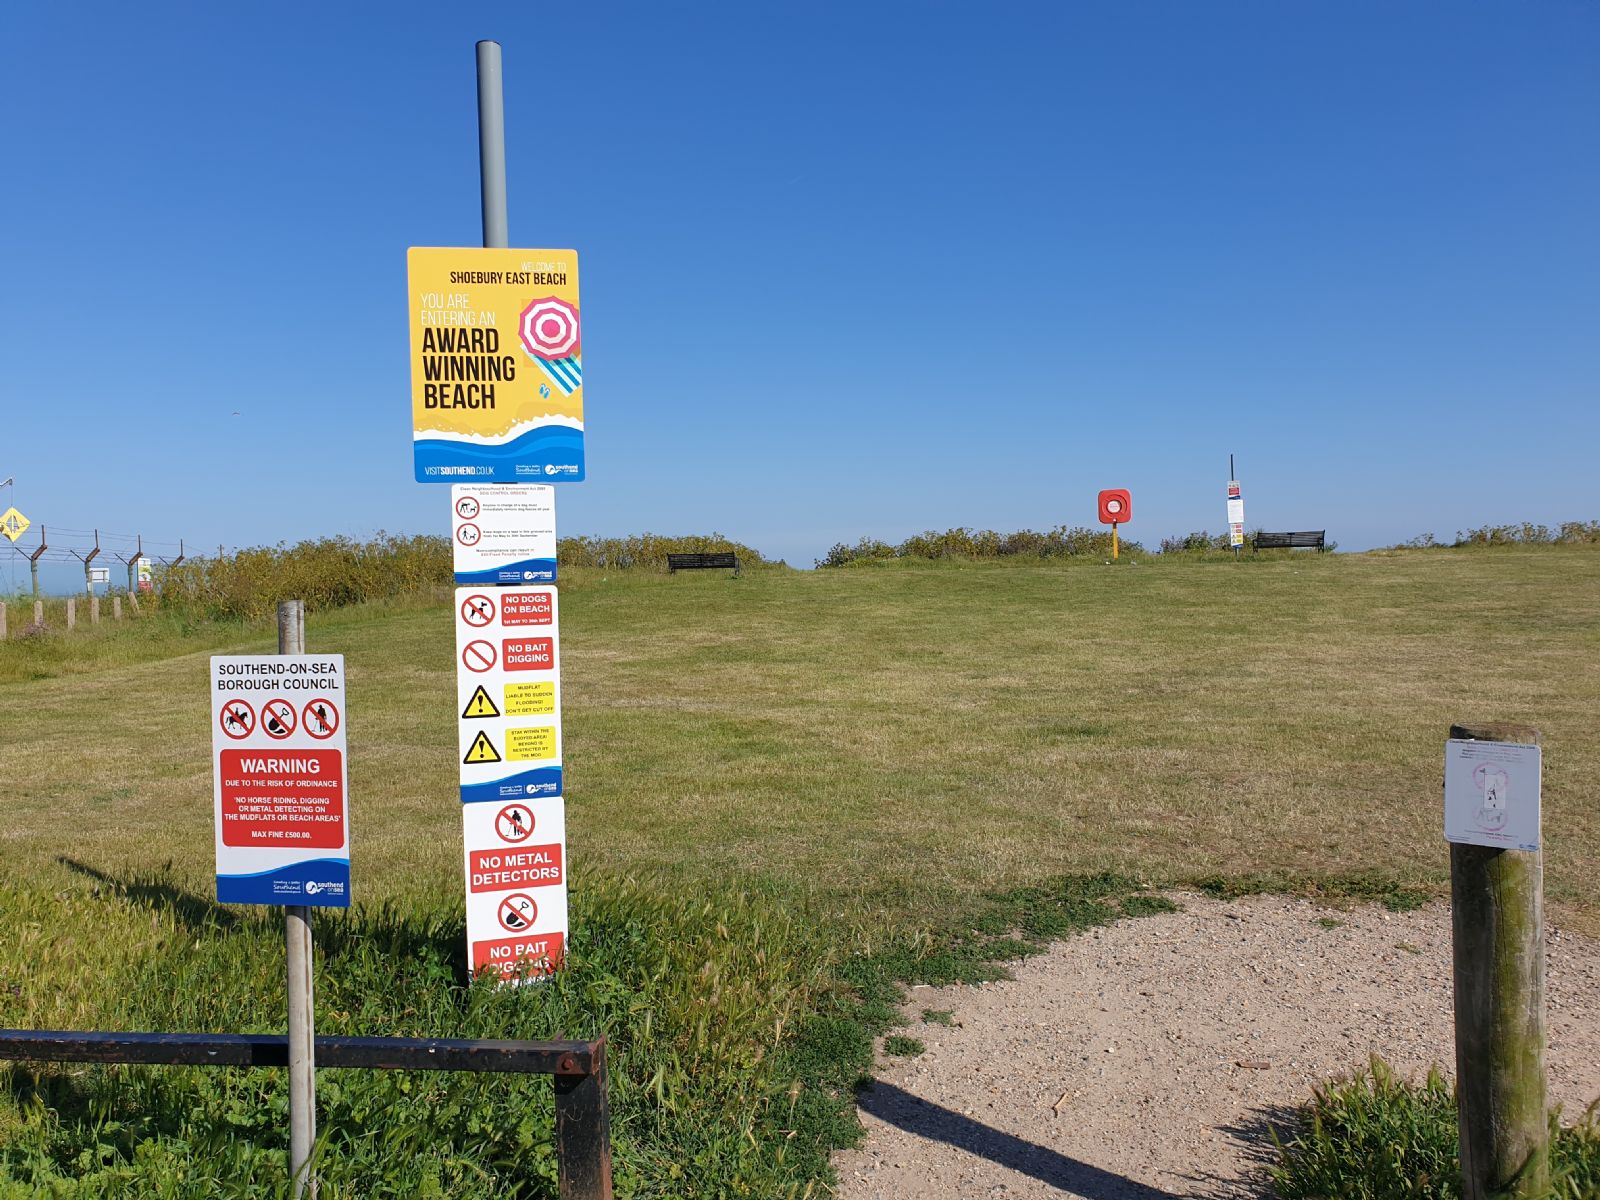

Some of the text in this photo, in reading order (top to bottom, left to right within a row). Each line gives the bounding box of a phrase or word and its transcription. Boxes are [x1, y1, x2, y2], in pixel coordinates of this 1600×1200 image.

[521, 262, 566, 272] WELCOME TO
[450, 271, 566, 286] SHOEBURY EAST BEACH
[421, 293, 470, 308] YOU ARE
[421, 310, 496, 326] ENTERING AN
[422, 328, 500, 353] AWARD
[422, 356, 516, 382] WINNING
[424, 384, 496, 409] BEACH
[525, 644, 547, 652] BAIT
[508, 654, 549, 663] DIGGING
[219, 663, 337, 675] SOUTHEND-ON-SEA
[218, 679, 338, 690] BOROUGH COUNCIL
[240, 758, 320, 774] WARNING
[480, 852, 552, 869] NO METAL
[473, 867, 560, 886] DETECTORS
[490, 941, 548, 959] NO BAIT
